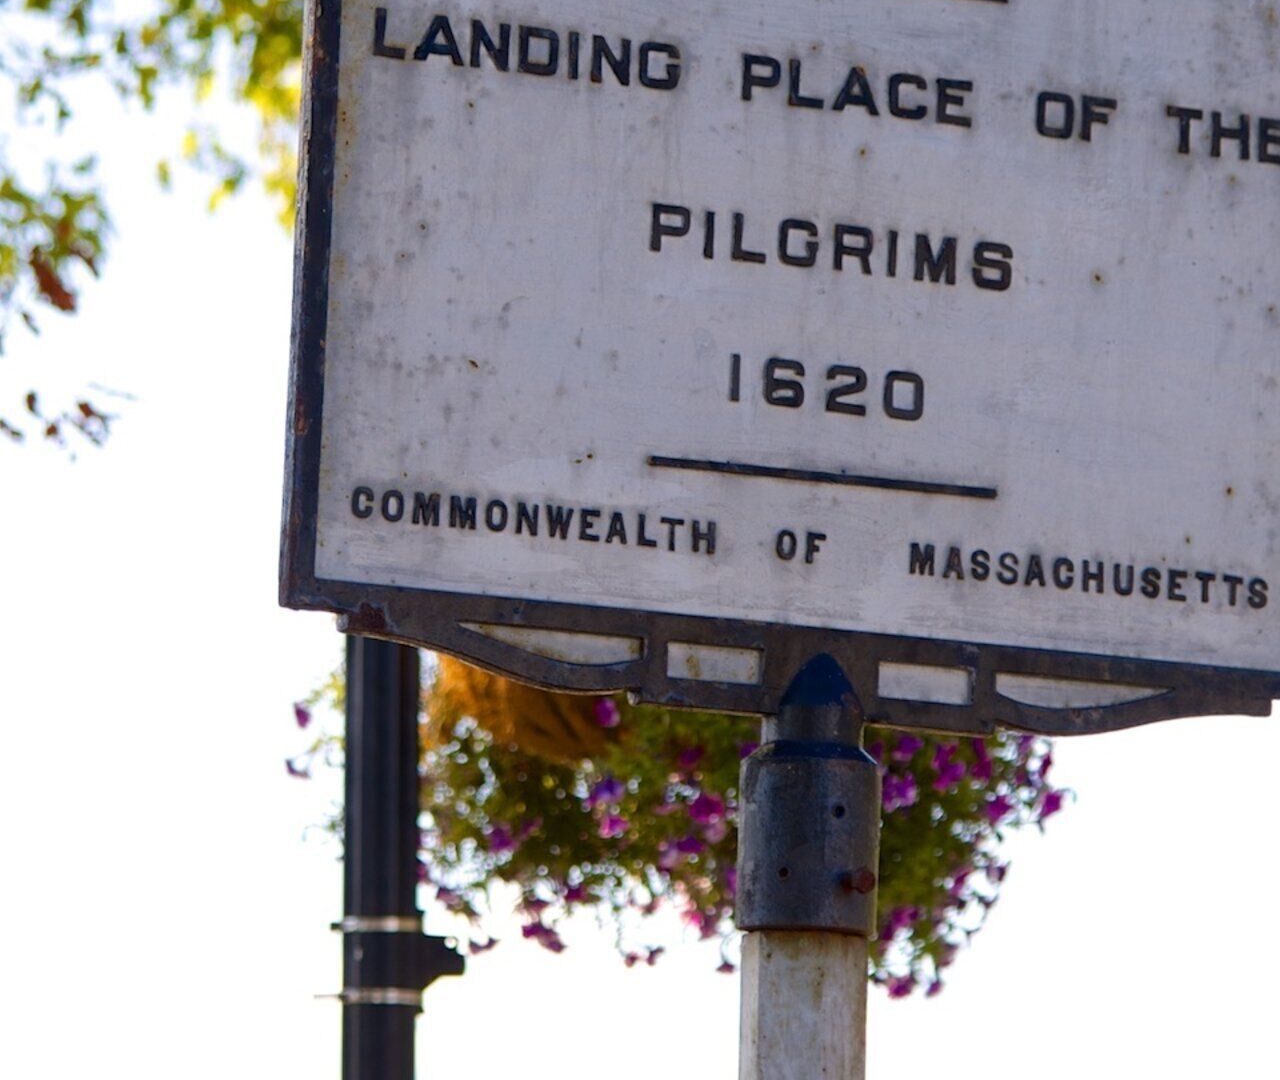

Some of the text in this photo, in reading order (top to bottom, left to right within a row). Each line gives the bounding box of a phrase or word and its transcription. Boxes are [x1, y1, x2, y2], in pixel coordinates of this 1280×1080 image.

[370, 6, 683, 90] LANDING
[741, 52, 974, 129] PLACE
[1034, 90, 1118, 143] OF
[649, 202, 1014, 292] PILGRIMS
[729, 354, 924, 421] 1620
[350, 486, 1269, 610] COMMONWEALTH OF MASSACHUSETTS
